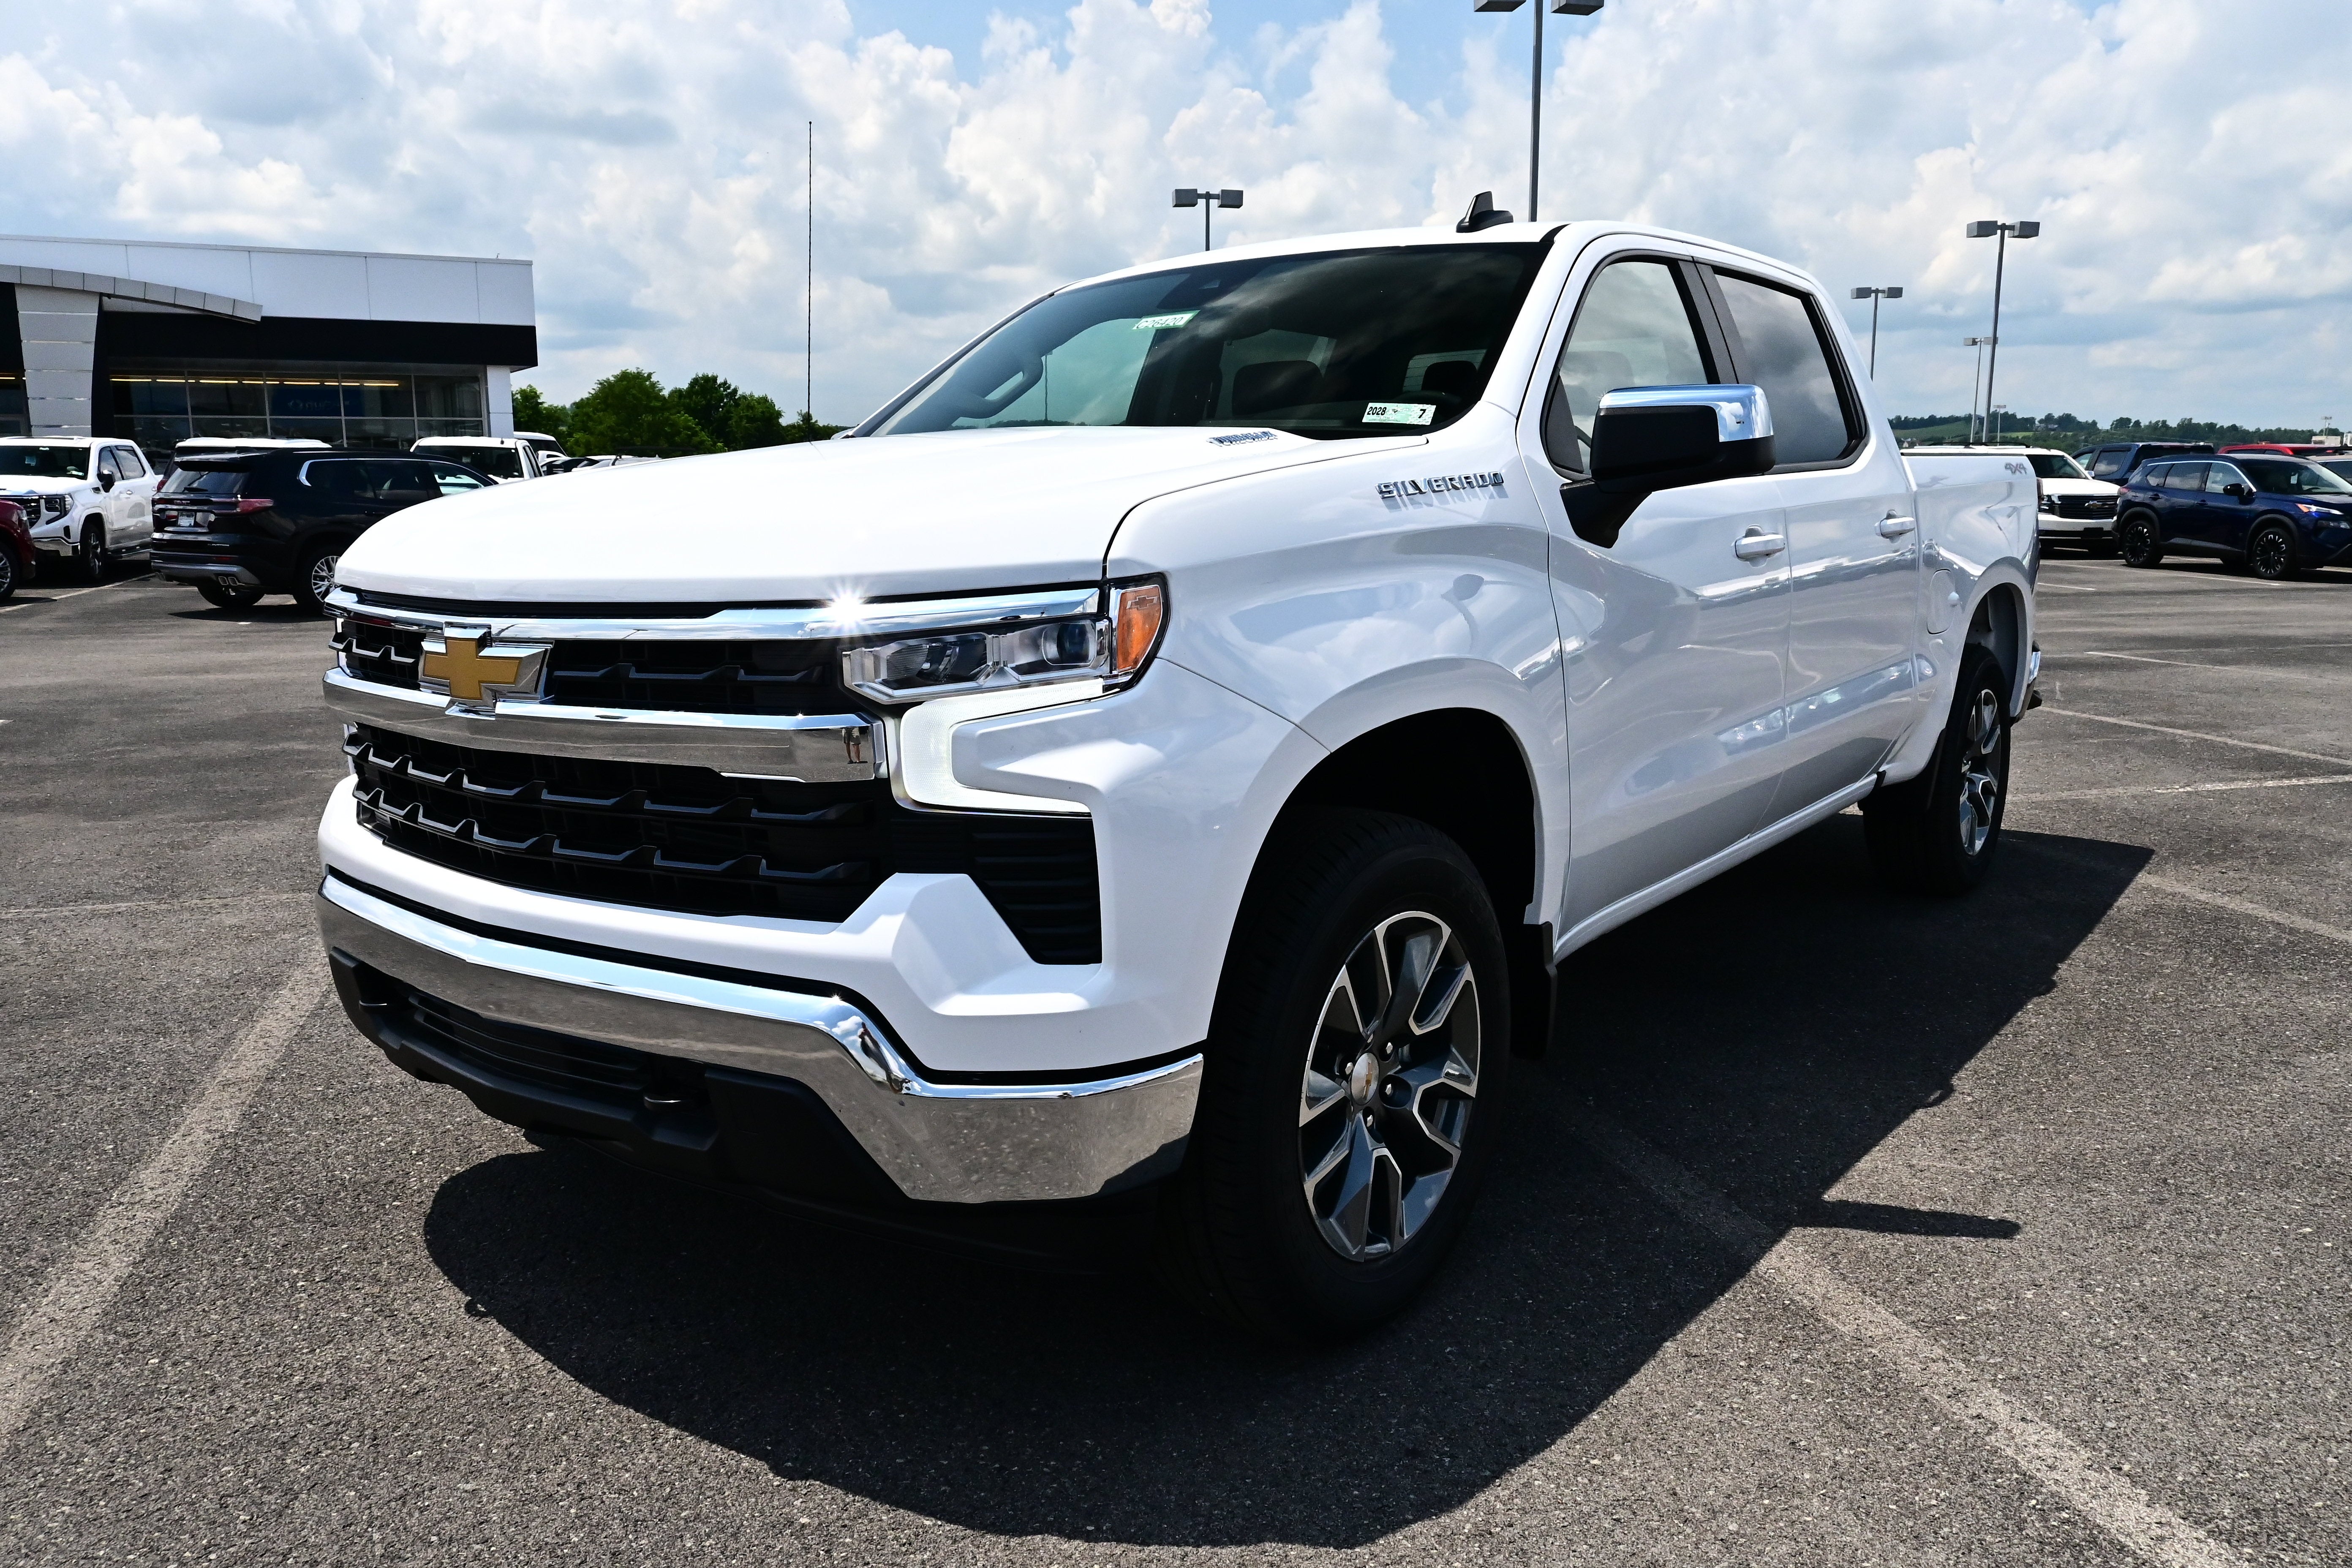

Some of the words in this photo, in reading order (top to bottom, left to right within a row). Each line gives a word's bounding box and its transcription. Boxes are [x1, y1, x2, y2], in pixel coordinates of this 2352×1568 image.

[1136, 317, 1184, 329] C26420
[1367, 406, 1387, 416] 2028
[1418, 408, 1427, 419] 7
[1375, 471, 1505, 499] SILVERADO
